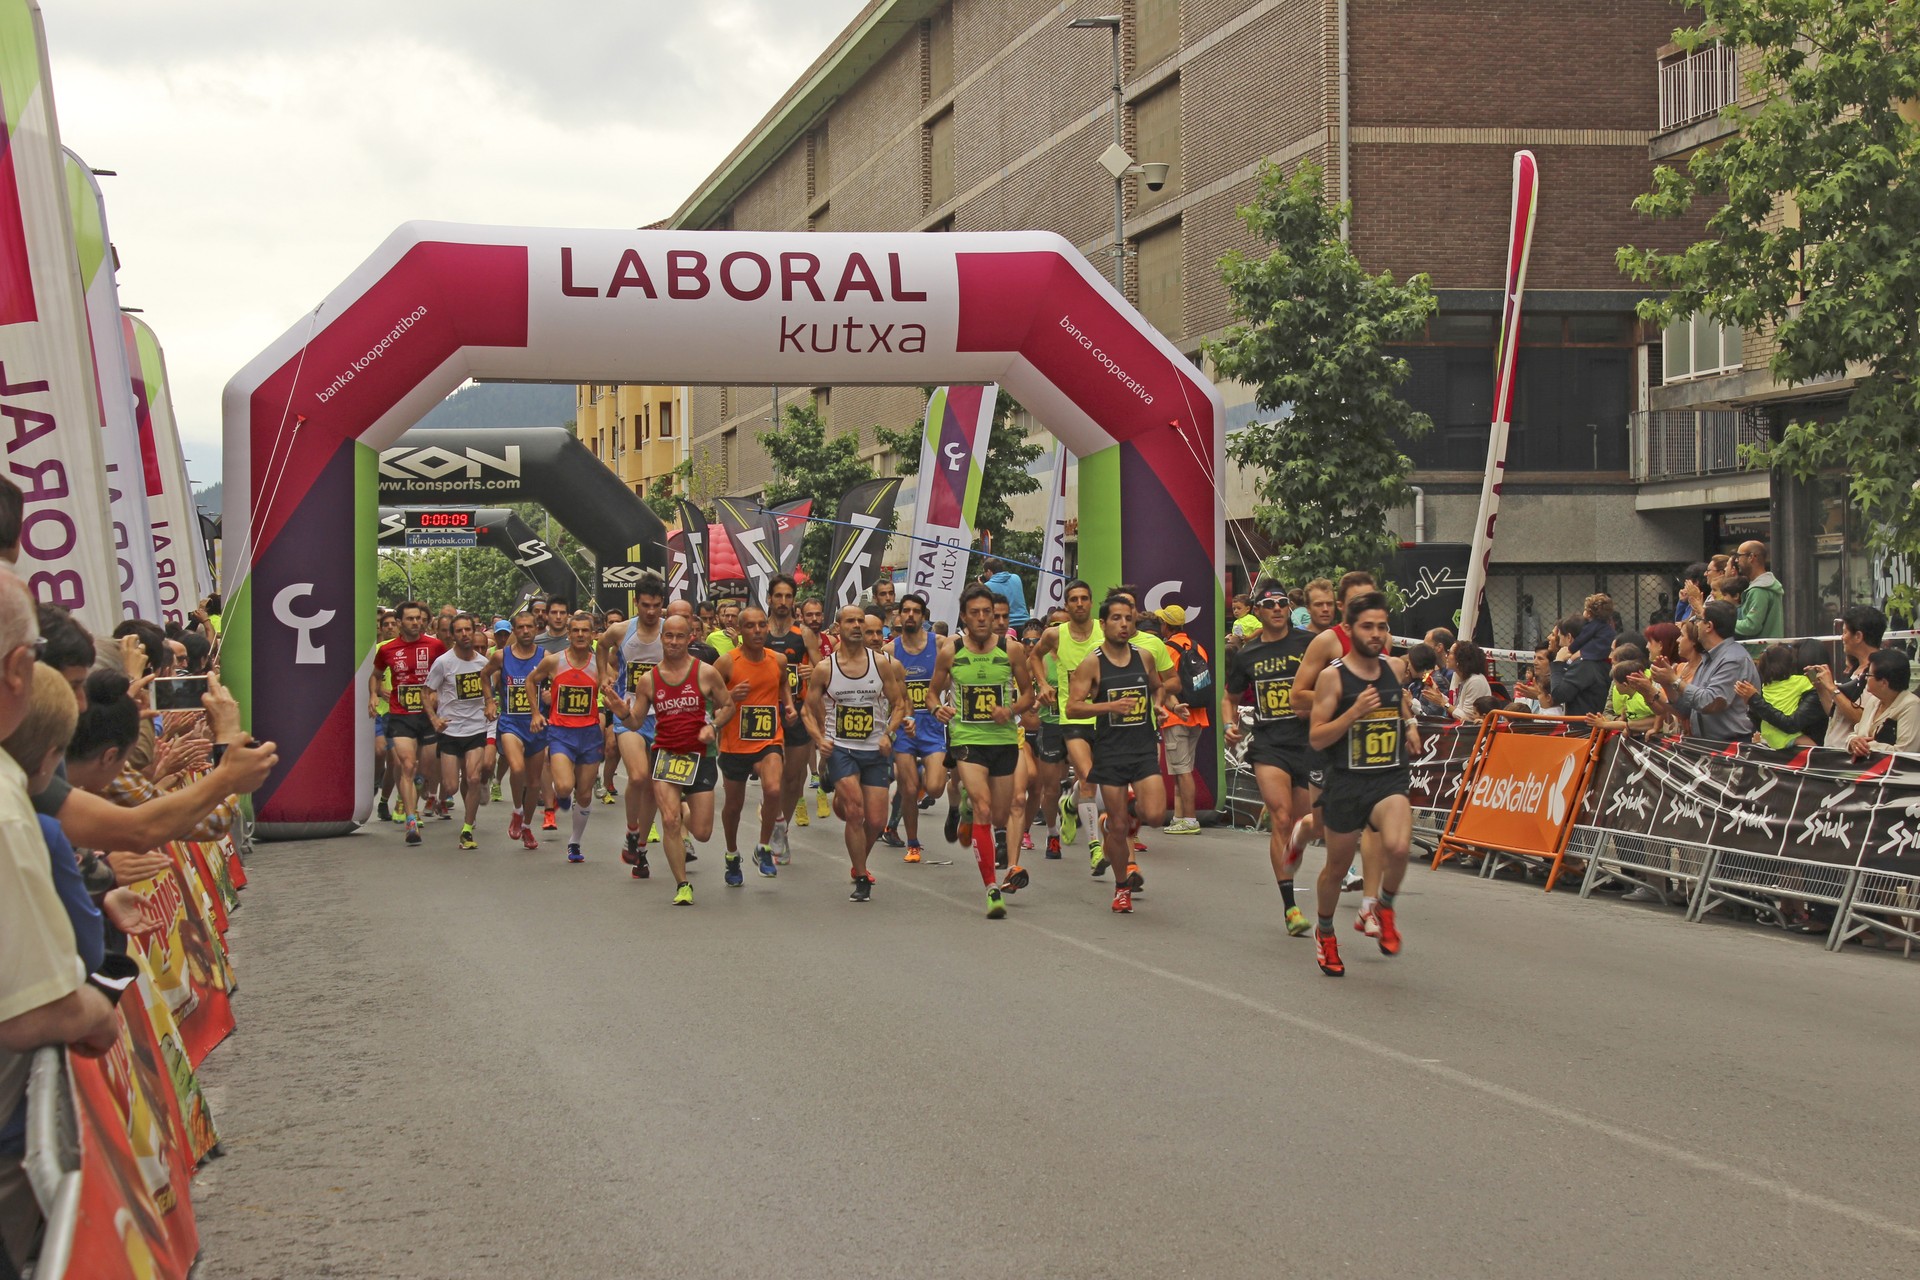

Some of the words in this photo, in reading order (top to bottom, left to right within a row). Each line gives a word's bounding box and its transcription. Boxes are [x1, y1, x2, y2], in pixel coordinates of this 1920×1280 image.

[561, 247, 927, 301] LABORAL
[779, 315, 927, 353] kutxa
[316, 370, 355, 403] banka
[351, 305, 427, 372] kooperatiboa
[1059, 315, 1093, 350] banca
[1092, 348, 1154, 405] cooperativa
[378, 479, 521, 492] ww.konsports.com
[421, 514, 468, 526] 0:00:09
[412, 537, 474, 546] Kirolprobak.com
[937, 537, 960, 590] kutxa
[1254, 656, 1287, 676] RUN
[568, 693, 589, 707] 114
[975, 693, 997, 712] 43
[1267, 688, 1292, 709] 62
[754, 714, 772, 731] 76
[843, 714, 874, 731] 632
[1365, 731, 1397, 755] 617
[668, 758, 695, 777] 167
[1472, 771, 1550, 814] euskaltel
[1796, 811, 1851, 850] Spiuk
[1877, 820, 1920, 857] Spi
